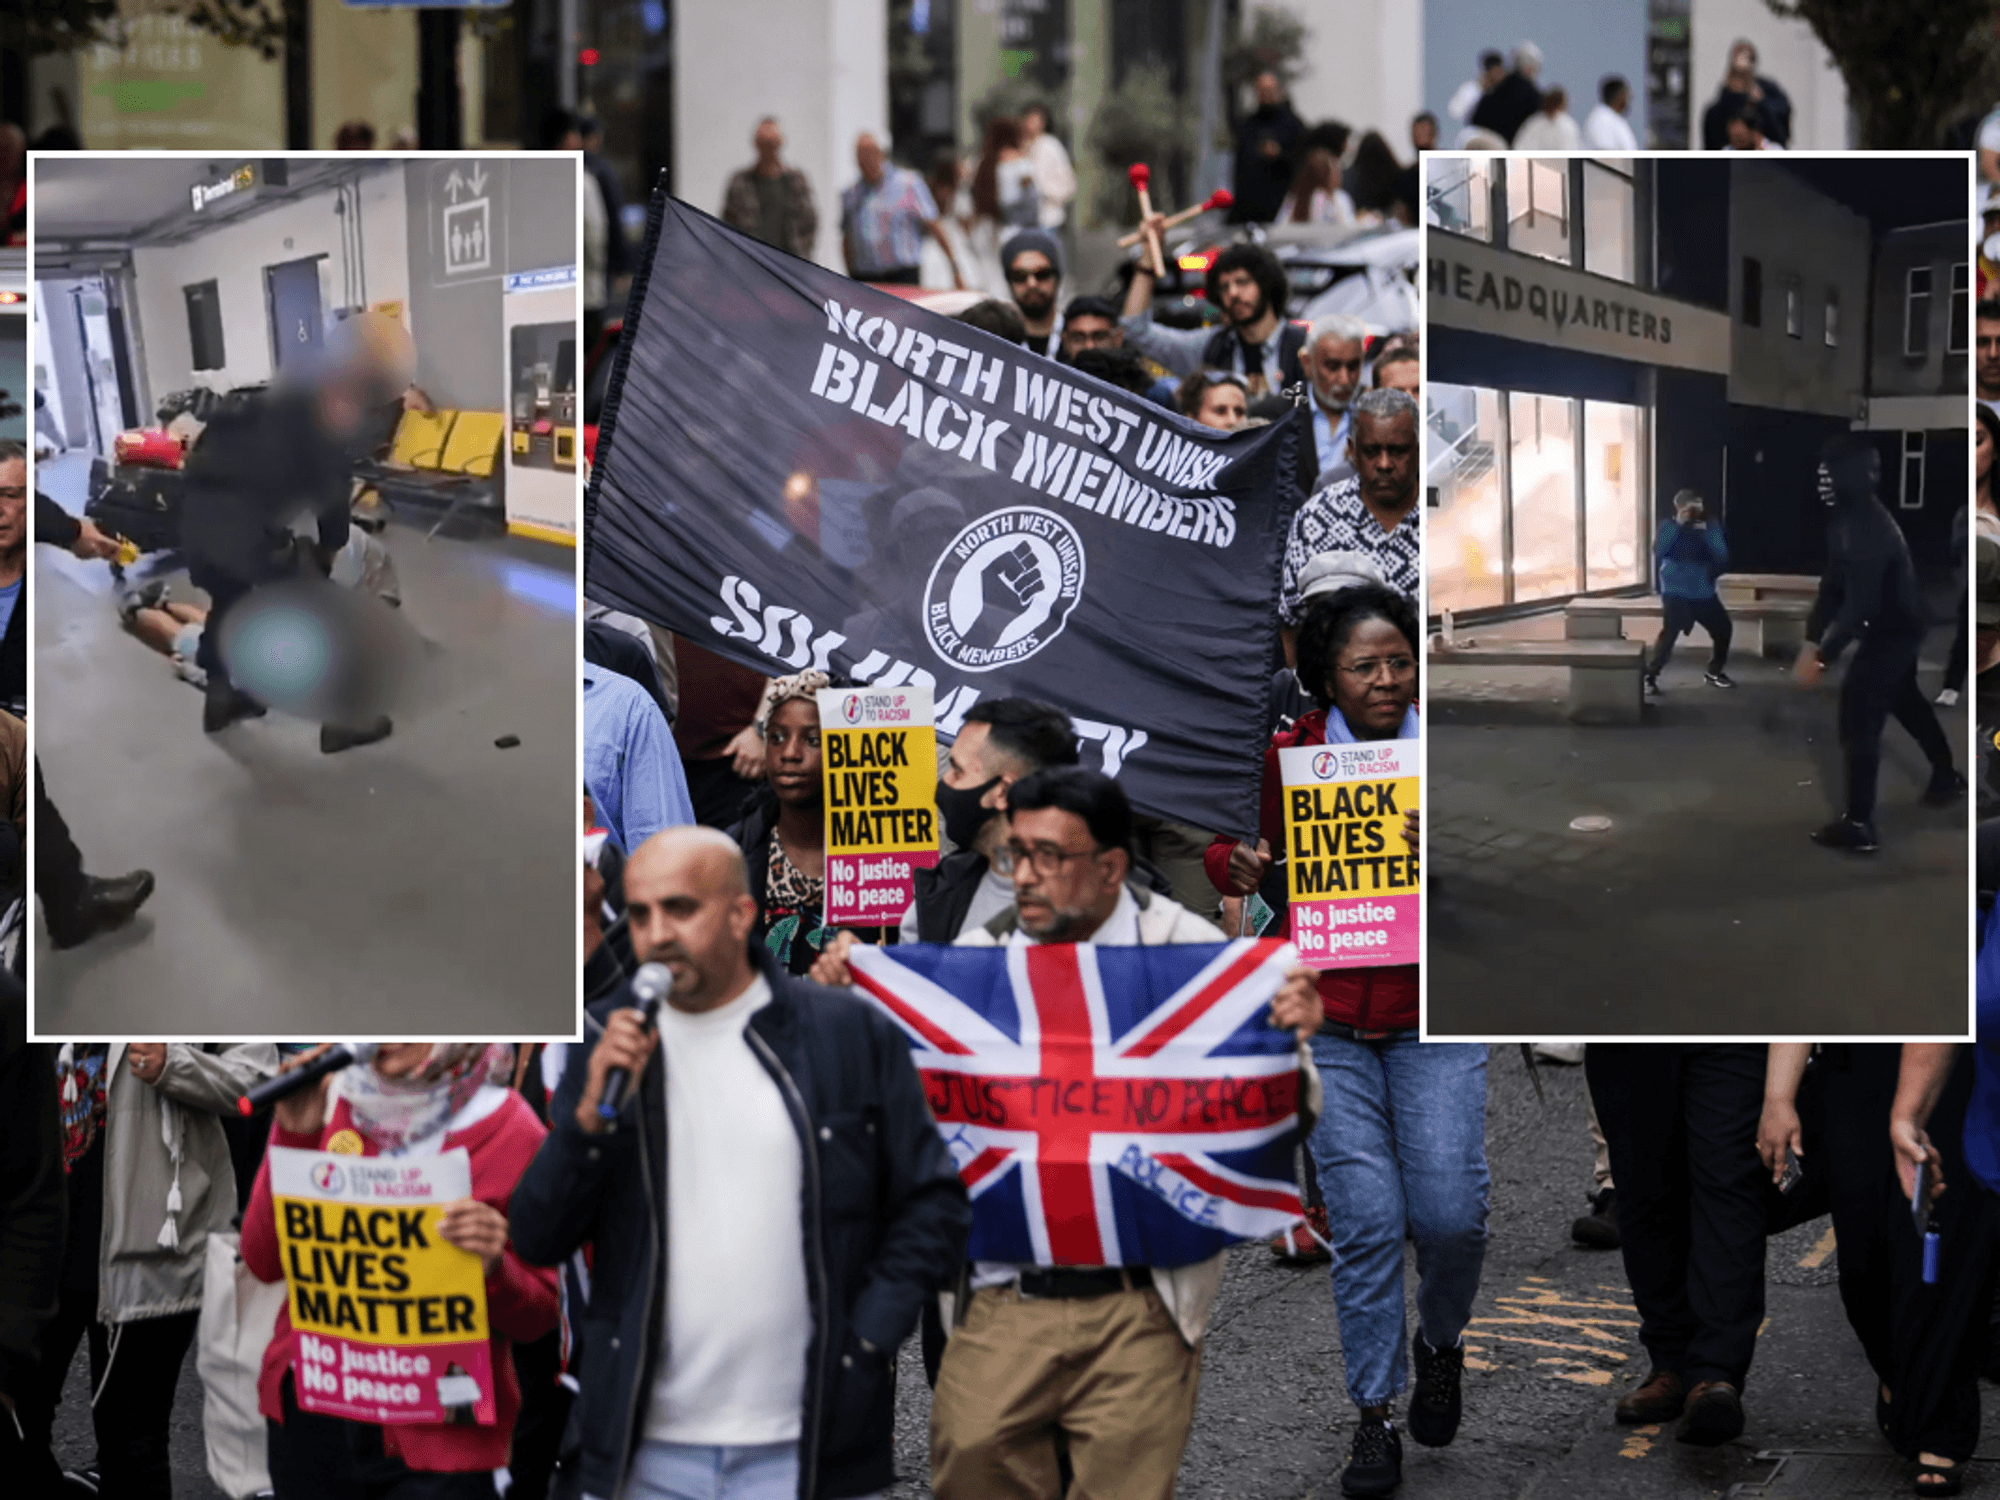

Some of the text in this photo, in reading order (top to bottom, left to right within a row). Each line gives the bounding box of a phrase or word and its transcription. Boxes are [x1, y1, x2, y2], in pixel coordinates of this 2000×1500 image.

[1427, 258, 1672, 344] HEADQUARTERS
[824, 299, 1005, 404] NORTH
[1014, 365, 1141, 454] WEST
[810, 342, 1237, 549] BLACK MEMBERS
[954, 513, 1080, 599] NORTH WEST UNISON
[931, 601, 1040, 664] BLACK MEMBERS
[864, 694, 906, 708] STAND UP
[866, 708, 910, 721] TO RACISM
[827, 731, 908, 769] BLACK
[1340, 747, 1393, 764] STAND UP
[1342, 761, 1400, 776] TO RACISM
[829, 770, 898, 807] LIVES
[1291, 782, 1399, 822] BLACK
[831, 808, 933, 847] MATTER
[1294, 820, 1385, 858] LIVES
[831, 857, 910, 887] No justice
[1295, 855, 1419, 894] MATTER
[831, 884, 905, 911] No peace
[1297, 901, 1396, 930] No justice
[1298, 929, 1388, 954] No peace
[931, 1074, 1292, 1126] JUSTICE NO PEACE
[1118, 1143, 1225, 1225] POLICE
[284, 1202, 430, 1249] BLACK
[288, 1245, 411, 1293] LIVES
[296, 1285, 477, 1336] MATTER
[301, 1333, 431, 1377] No justice
[302, 1362, 421, 1403] No peace
